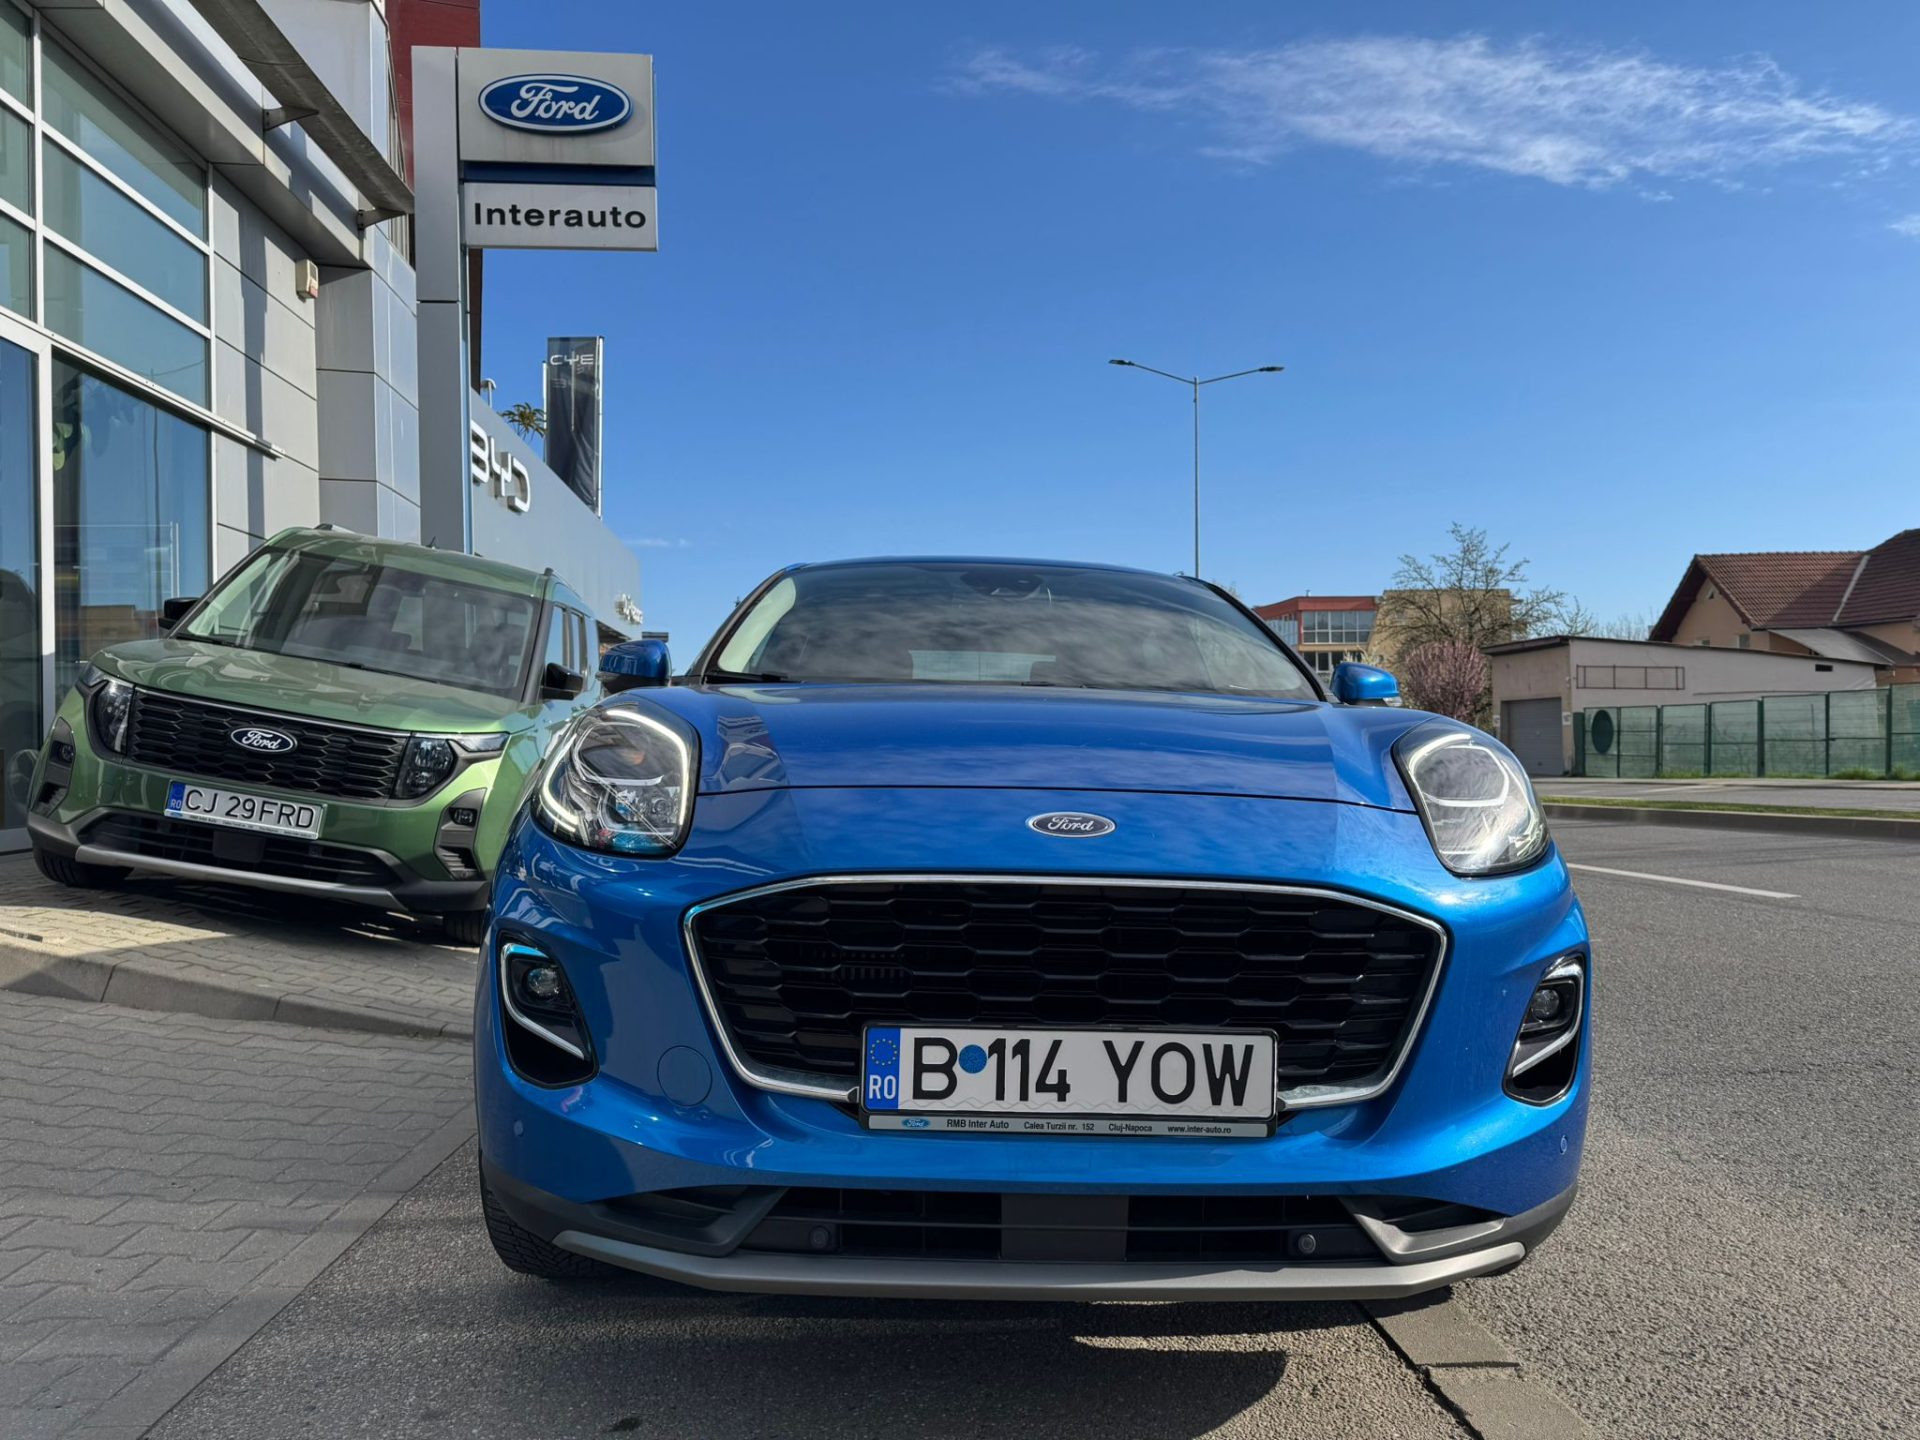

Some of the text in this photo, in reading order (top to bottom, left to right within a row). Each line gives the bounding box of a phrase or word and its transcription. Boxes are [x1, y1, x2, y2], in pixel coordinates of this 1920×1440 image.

[511, 83, 601, 120] Ford
[475, 203, 646, 228] Interauto
[470, 419, 530, 513] BYD
[242, 730, 281, 749] Ford
[170, 798, 182, 809] RO
[186, 789, 218, 813] CJ
[1048, 816, 1094, 831] Ford
[913, 1037, 1254, 1106] B 114 YOW
[868, 1074, 896, 1100] RO
[947, 1119, 1009, 1129] RMB Inter Auto
[1023, 1121, 1044, 1130] Calea
[1068, 1123, 1078, 1131] nr.
[1082, 1123, 1095, 1131] 152
[1108, 1123, 1152, 1133] Cluj-Napoca
[1167, 1125, 1231, 1134] www.inter-auto.ro
